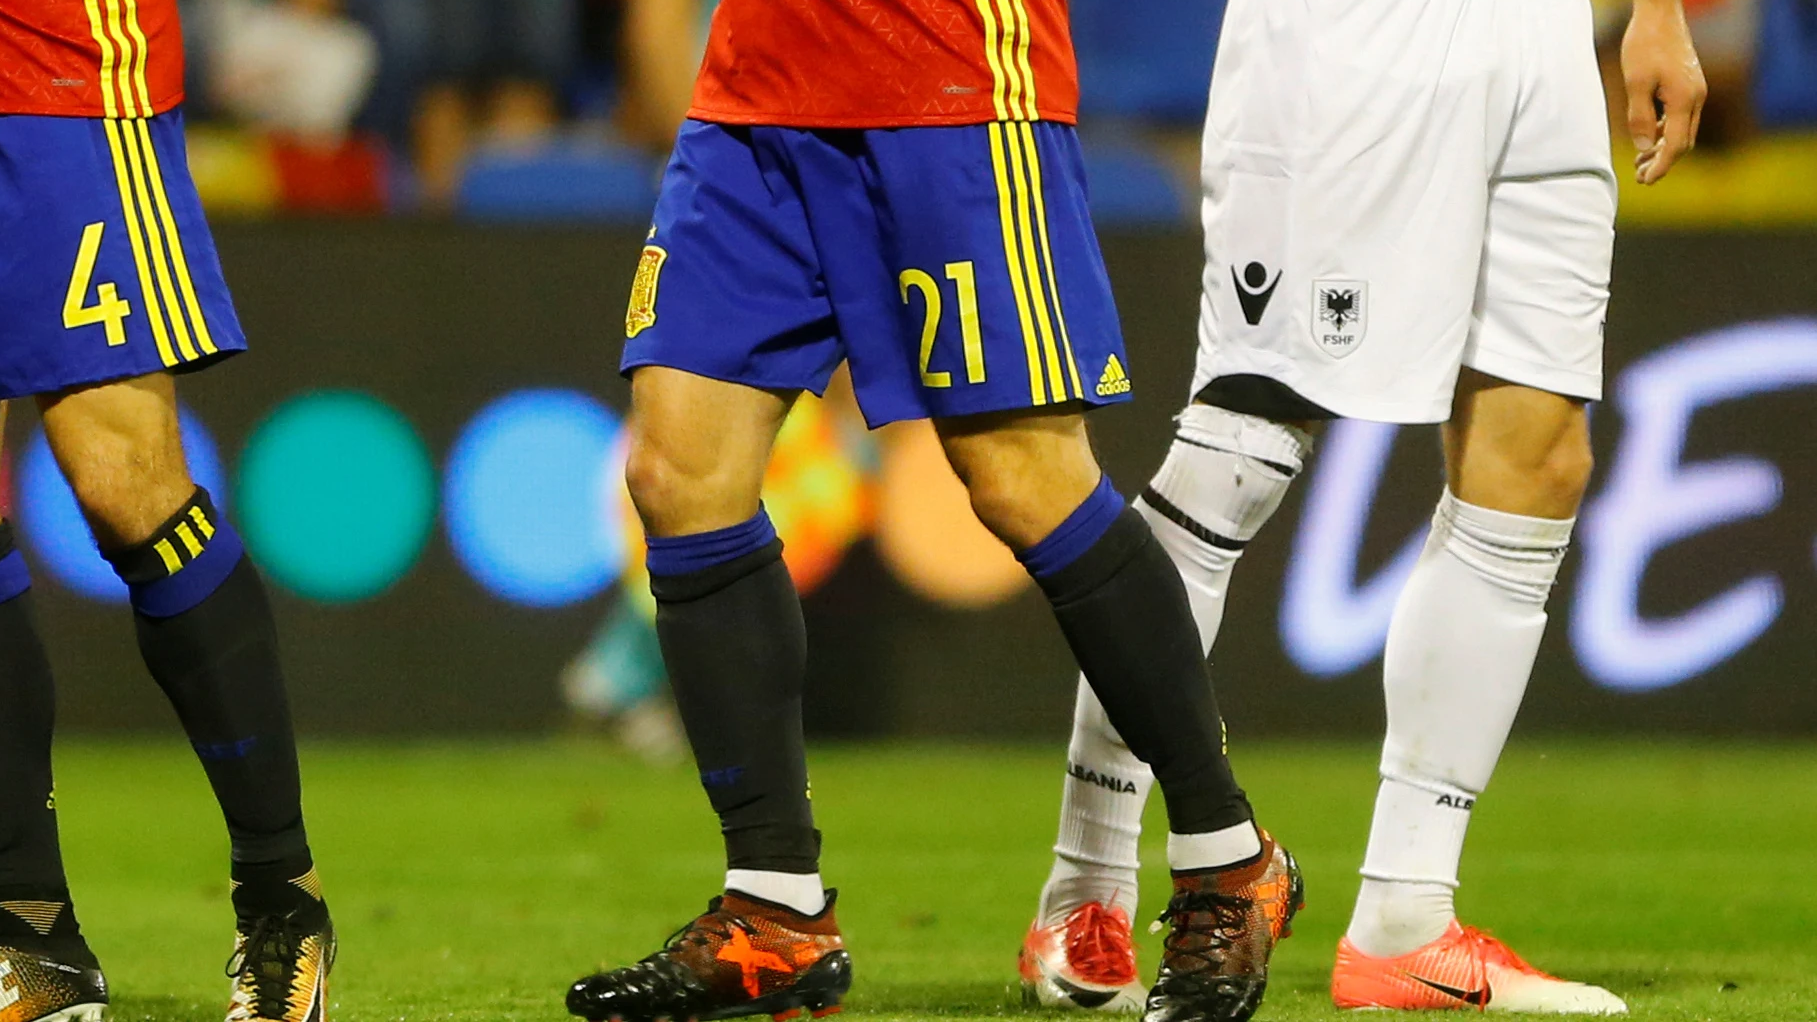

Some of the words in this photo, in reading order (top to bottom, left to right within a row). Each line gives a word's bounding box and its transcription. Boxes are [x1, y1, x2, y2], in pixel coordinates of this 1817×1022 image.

[61, 221, 132, 347] 4
[899, 260, 987, 389] 21
[1323, 334, 1355, 346] FSHF
